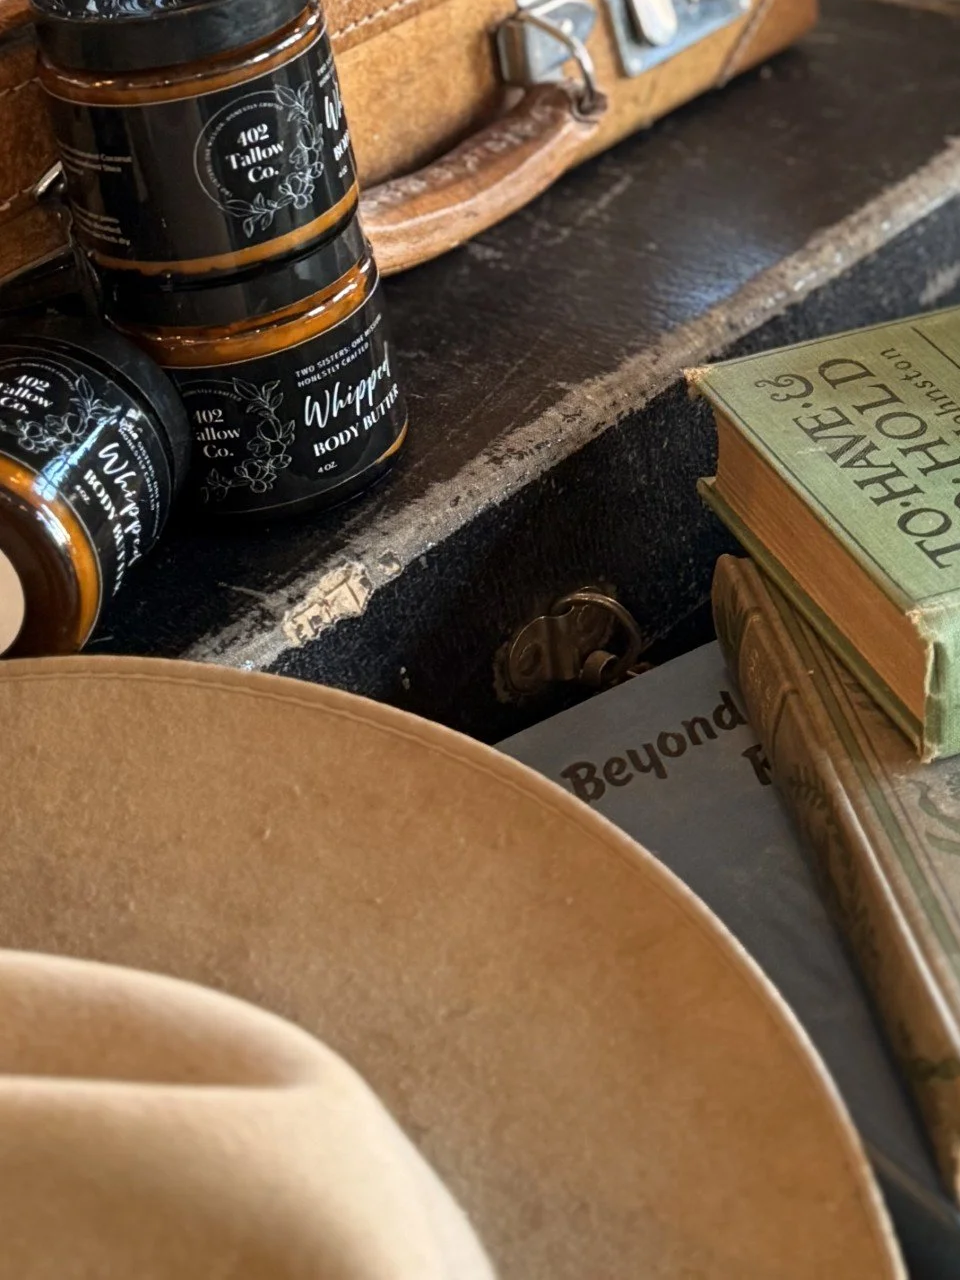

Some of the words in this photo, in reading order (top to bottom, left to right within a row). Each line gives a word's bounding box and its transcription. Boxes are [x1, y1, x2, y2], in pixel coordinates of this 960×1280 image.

[225, 140, 285, 170] Tallow
[236, 123, 270, 147] 402
[247, 165, 280, 183] Co.
[295, 364, 315, 378] TWO
[351, 335, 364, 349] ONE
[297, 364, 340, 387] HONESTLY
[341, 342, 369, 366] CRAFTED
[15, 375, 50, 392] 402
[305, 341, 391, 428] Whipped
[194, 427, 240, 441] allow
[313, 422, 359, 457] BODY
[363, 383, 399, 430] BUTTER
[203, 444, 234, 458] Co.
[84, 469, 116, 520] BODY
[98, 442, 142, 567] Whipped
[560, 690, 746, 804] Beyond
